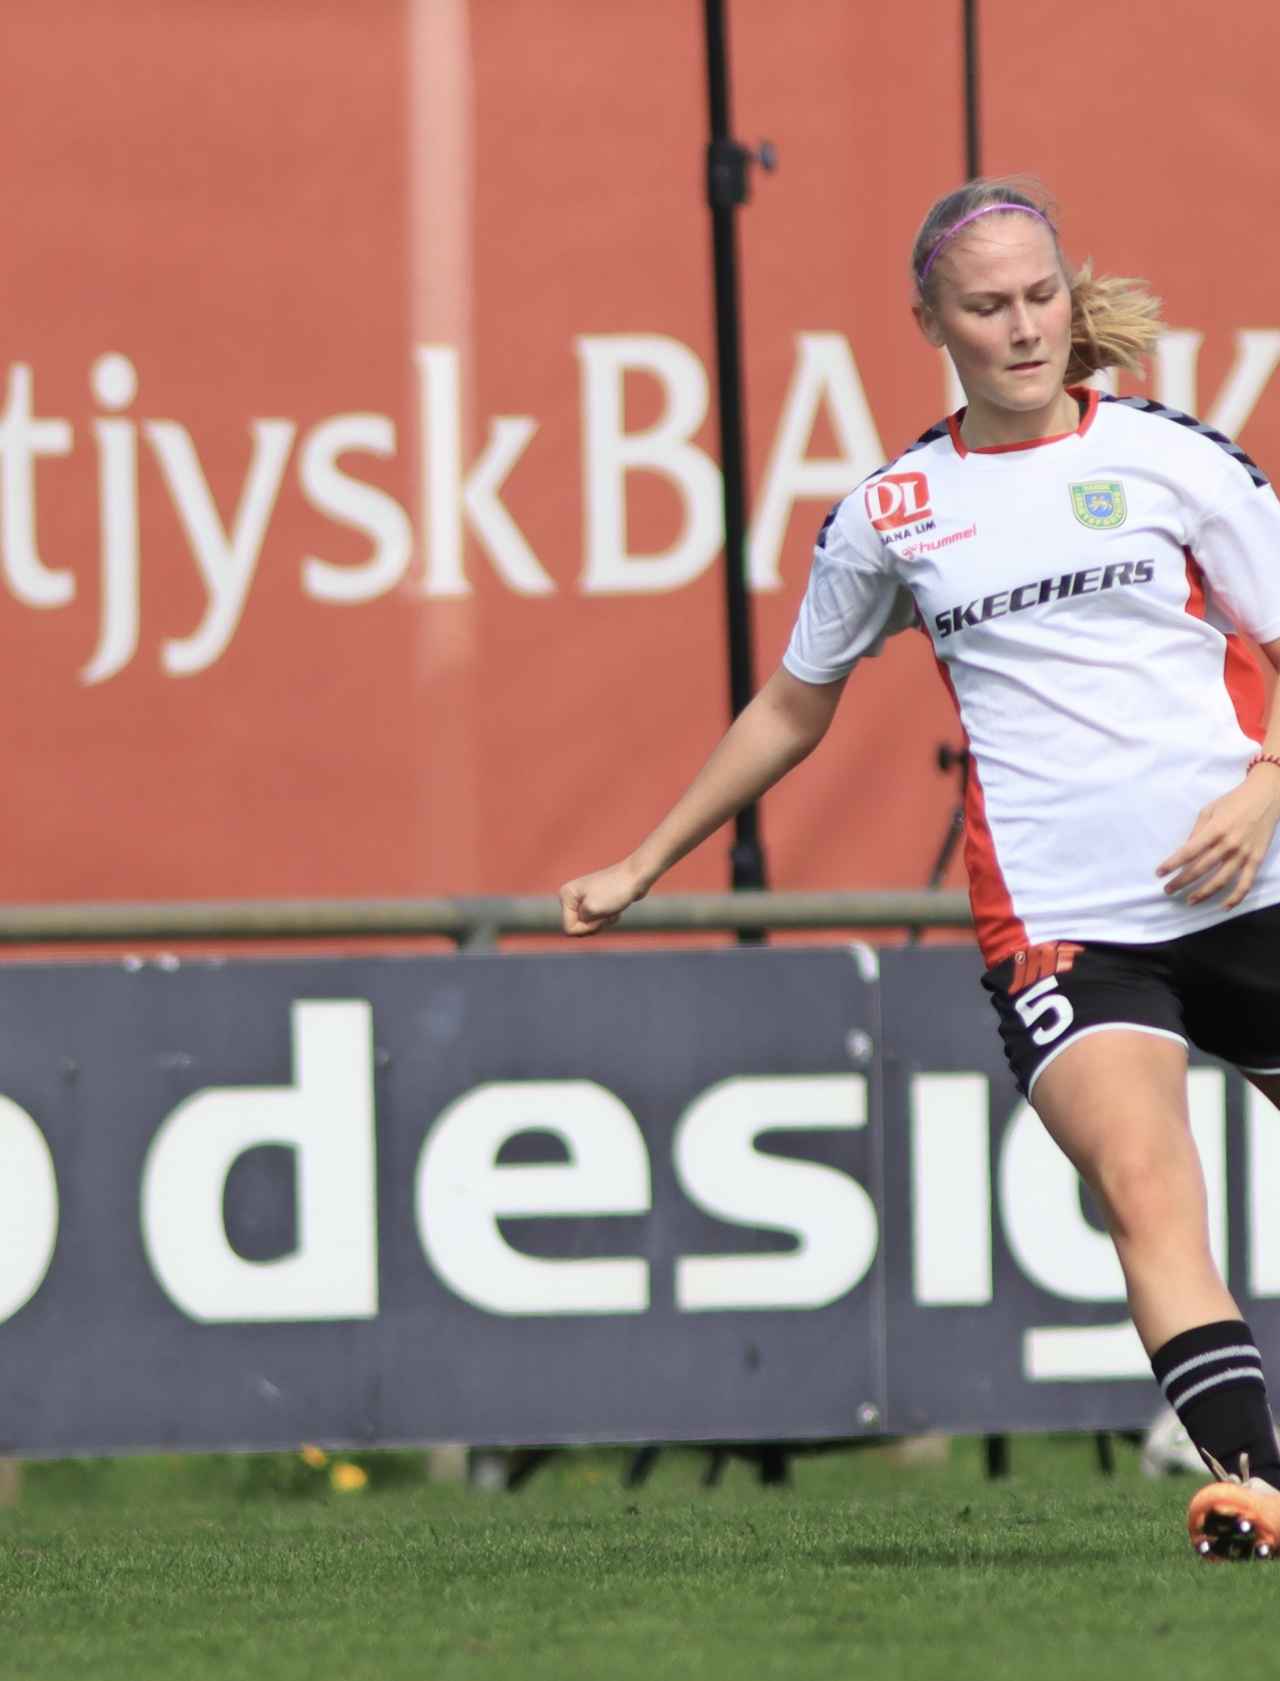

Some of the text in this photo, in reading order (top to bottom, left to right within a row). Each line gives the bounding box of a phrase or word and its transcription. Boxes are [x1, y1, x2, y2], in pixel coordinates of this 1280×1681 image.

[866, 480, 931, 521] DL
[914, 519, 937, 535] LIM
[919, 522, 977, 554] hummel
[935, 557, 1156, 639] SKECHERS
[1015, 974, 1074, 1046] 5
